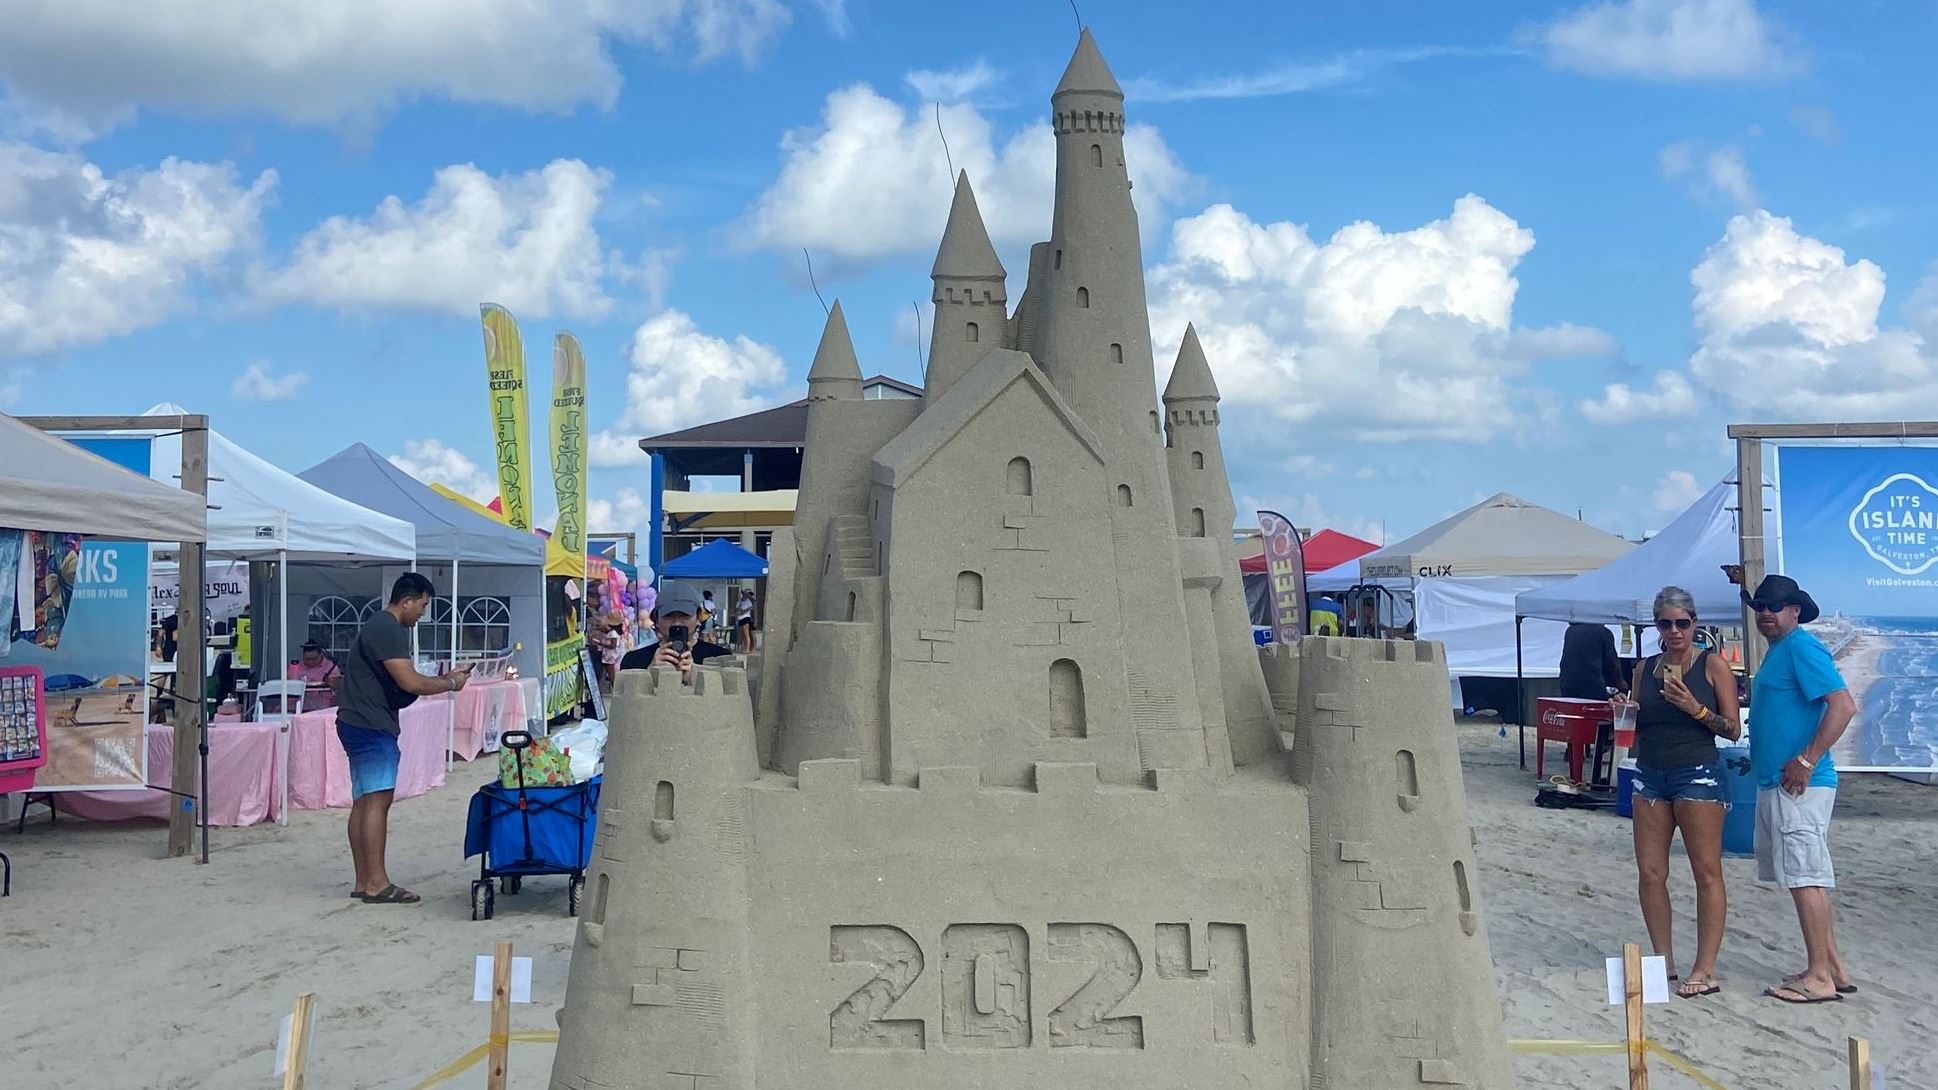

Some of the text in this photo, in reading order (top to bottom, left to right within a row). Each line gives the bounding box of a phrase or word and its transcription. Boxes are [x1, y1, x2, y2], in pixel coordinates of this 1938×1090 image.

[1890, 495, 1921, 508] IT'S
[1862, 510, 1938, 529] ISLAN
[1887, 532, 1926, 545] TIME
[75, 549, 118, 583] RKS
[829, 921, 1256, 1050] 2024
